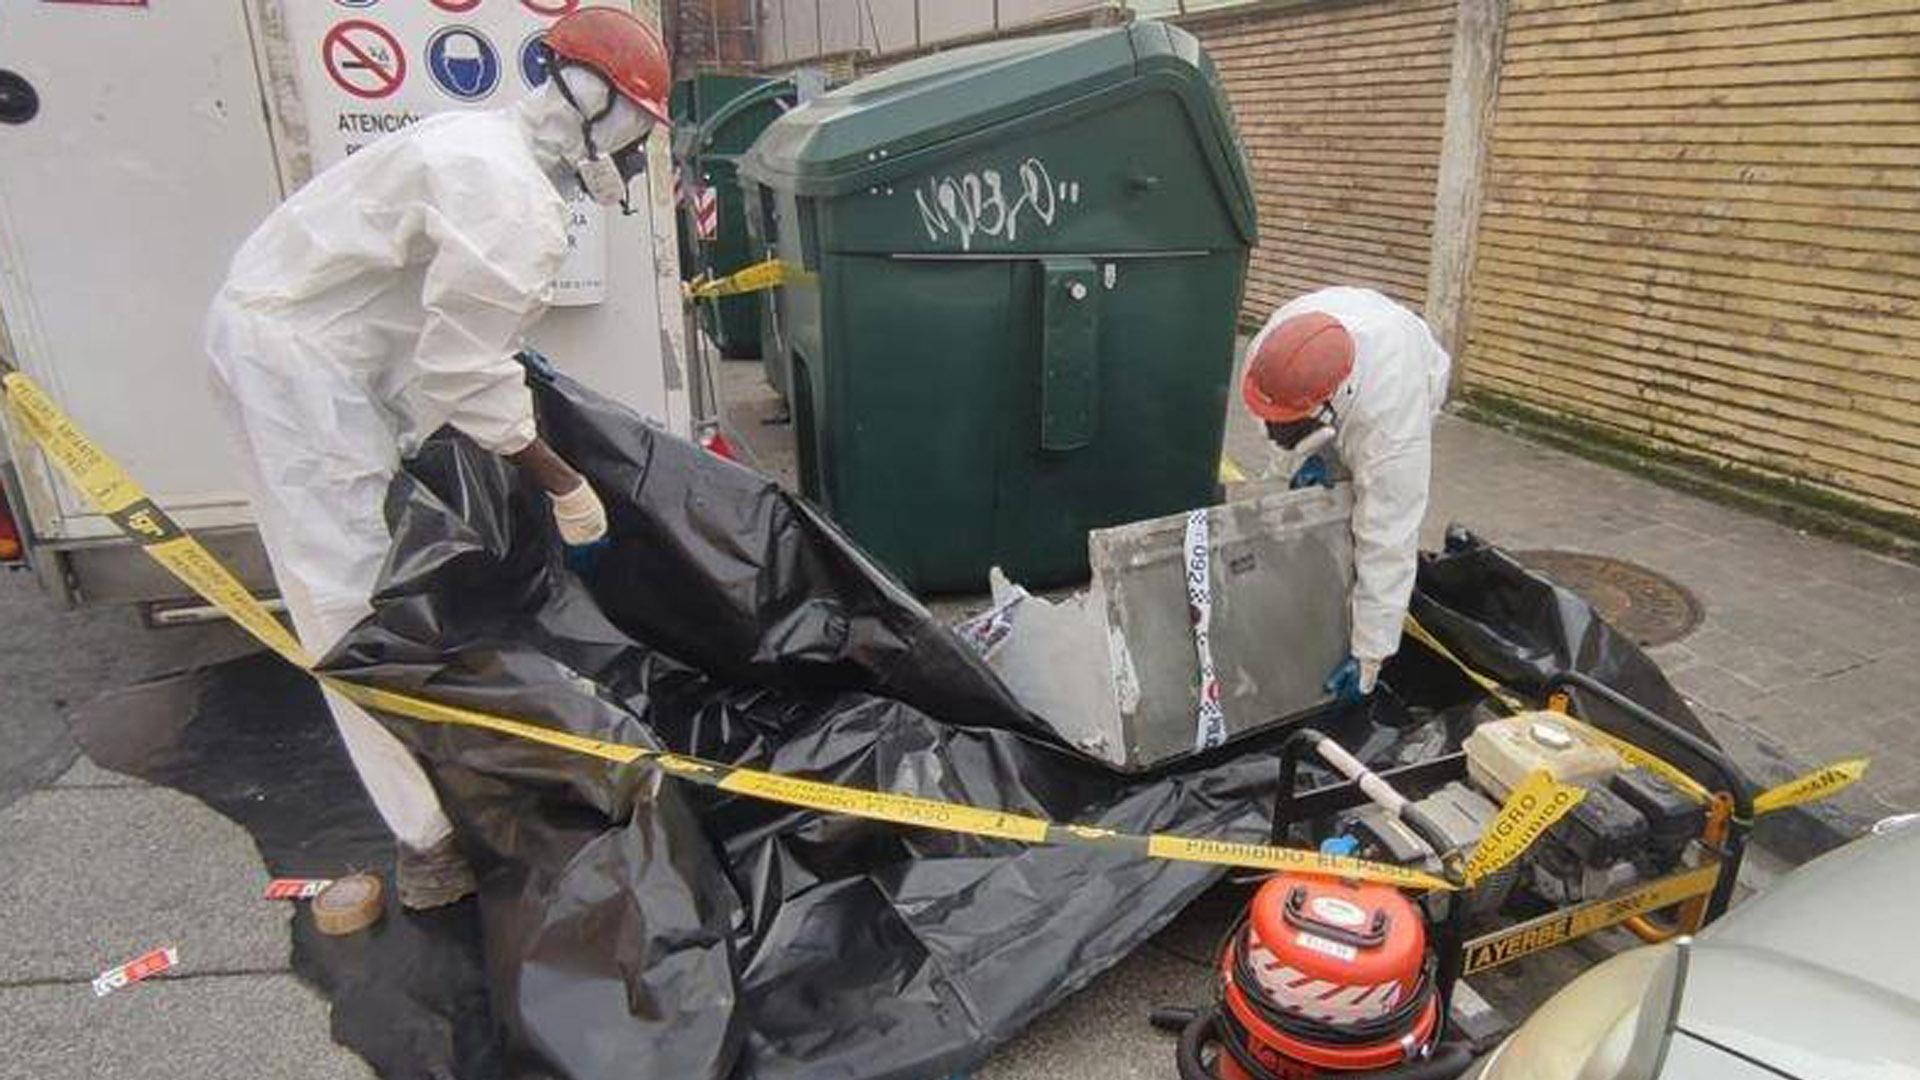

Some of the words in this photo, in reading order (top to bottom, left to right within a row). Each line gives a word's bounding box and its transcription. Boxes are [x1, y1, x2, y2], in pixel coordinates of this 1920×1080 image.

[338, 112, 421, 133] ATENCIÓ
[1188, 545, 1207, 584] 092
[1185, 838, 1304, 866] PROHIBIDO
[1474, 918, 1567, 968] AYERBE
